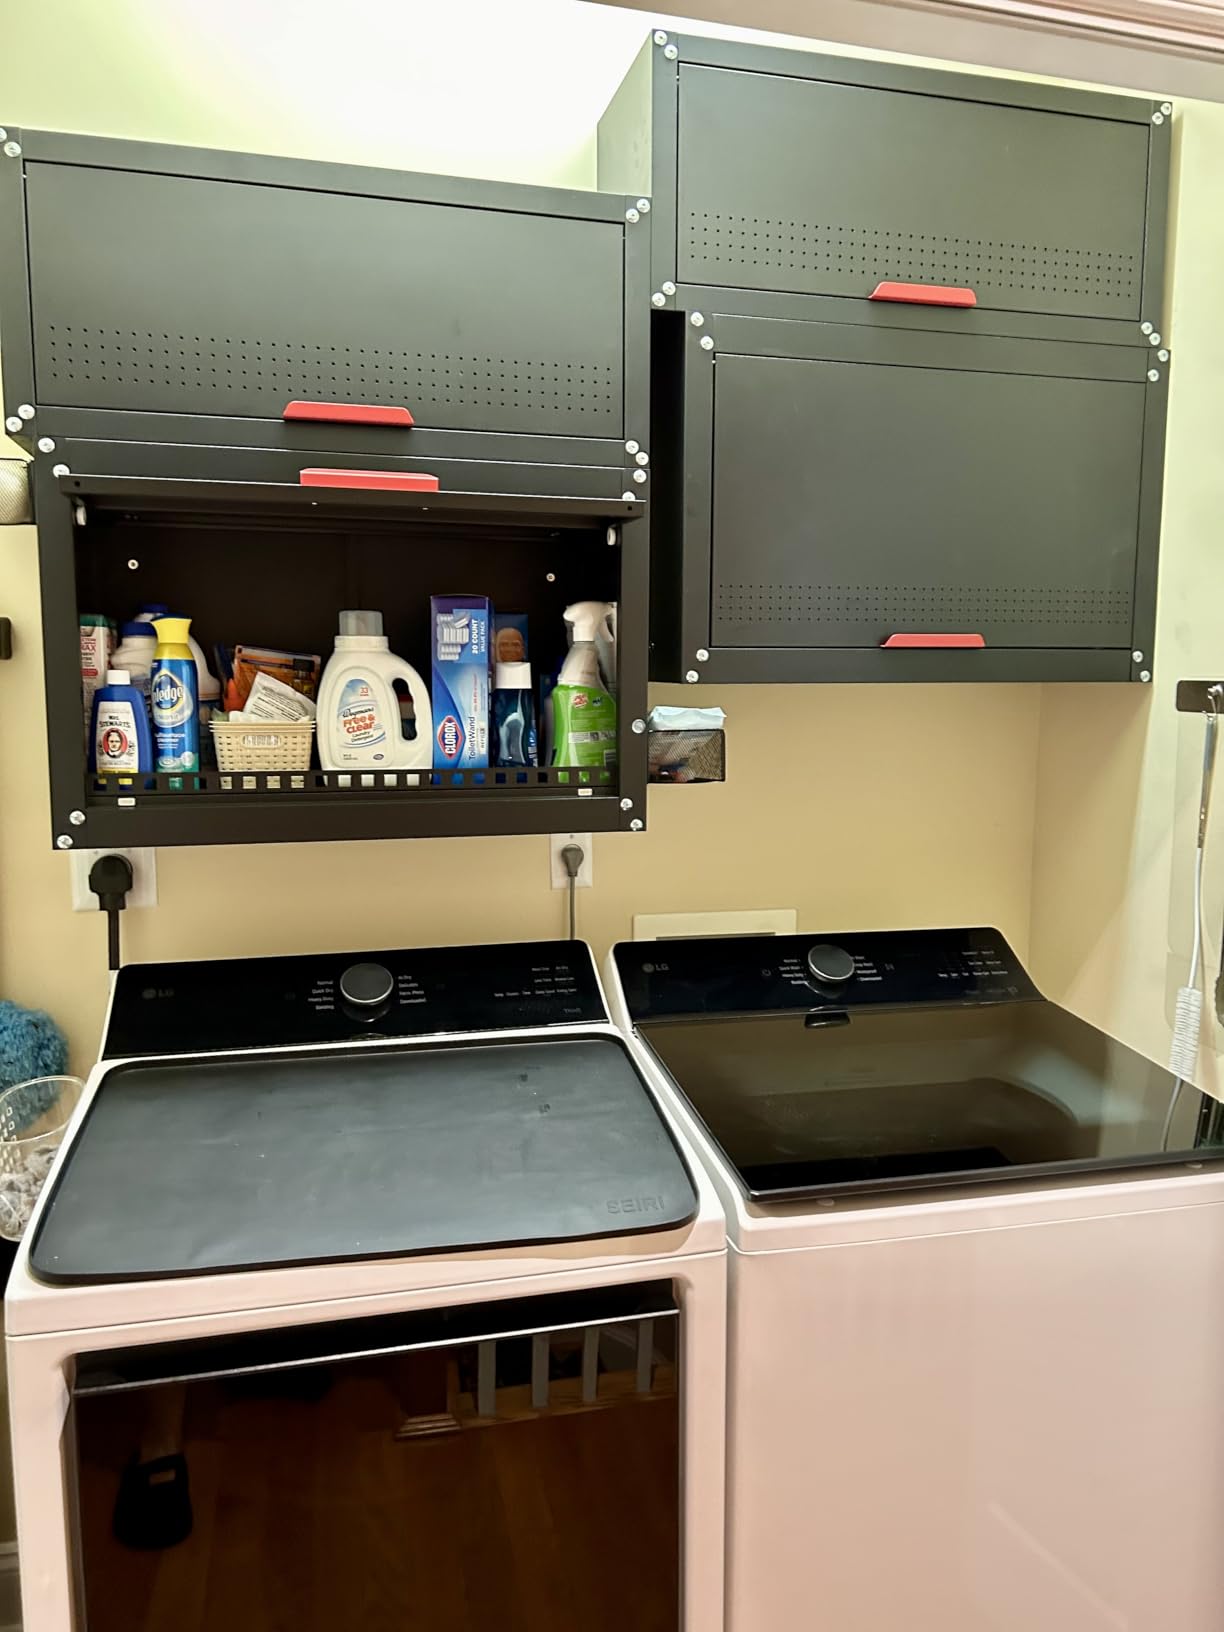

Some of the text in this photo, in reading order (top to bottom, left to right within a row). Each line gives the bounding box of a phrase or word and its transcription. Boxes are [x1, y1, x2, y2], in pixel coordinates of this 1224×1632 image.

[444, 721, 457, 755] CLOROX
[468, 716, 476, 761] ToiletWand
[655, 963, 670, 971] LG
[605, 1195, 665, 1214] SEIRI
